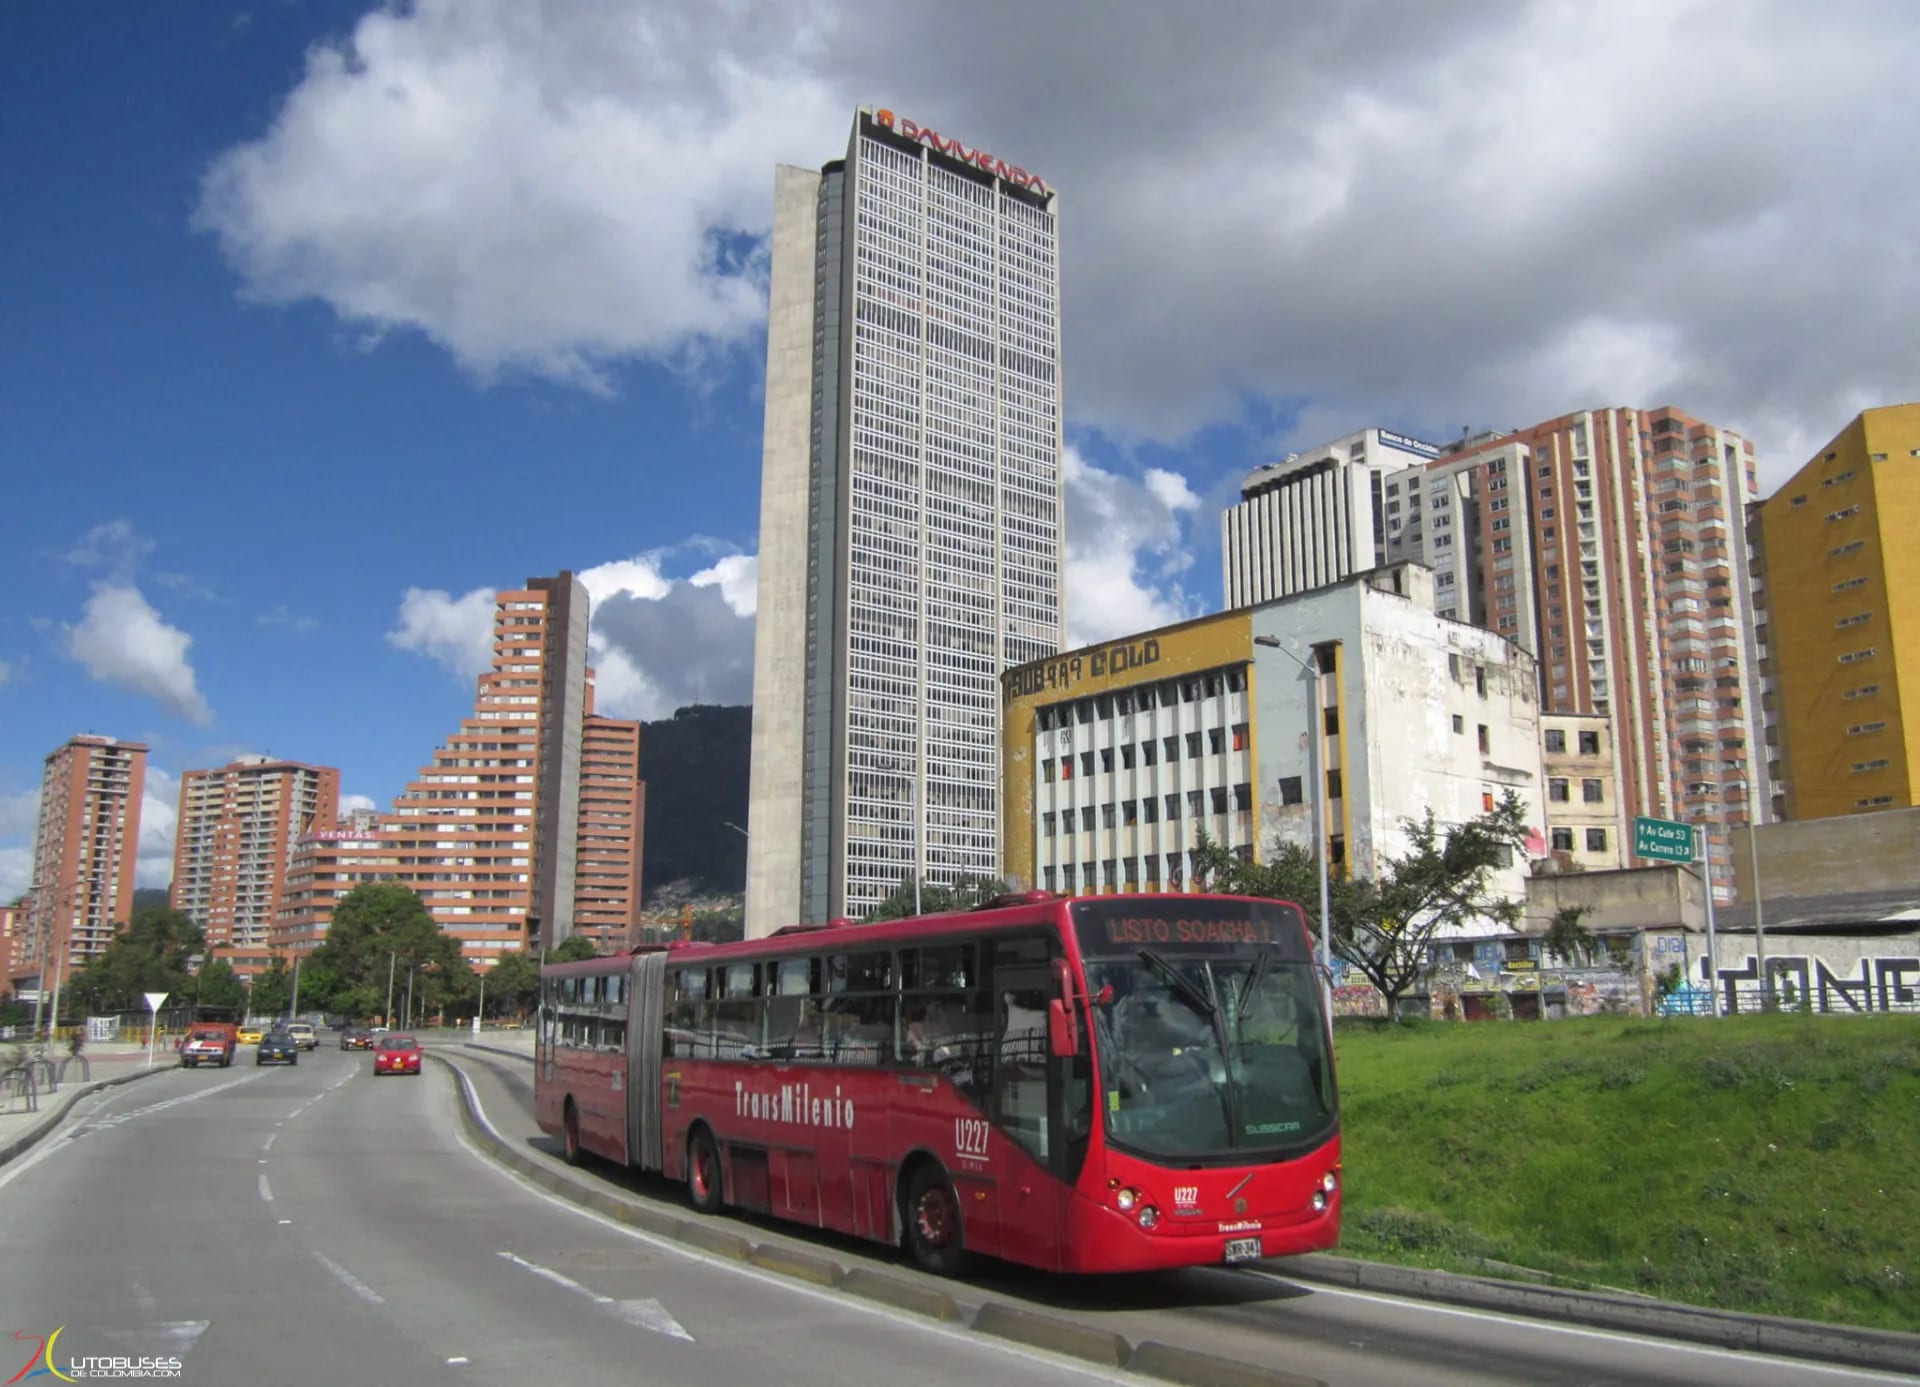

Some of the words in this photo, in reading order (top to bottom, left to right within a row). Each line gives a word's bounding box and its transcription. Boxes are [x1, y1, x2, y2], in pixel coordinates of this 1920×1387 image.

[901, 118, 1046, 194] DAVIVIENDA
[319, 831, 372, 839] VENTAS
[1646, 825, 1656, 836] Av
[1639, 840, 1648, 851] Av
[735, 1081, 854, 1129] TransMilenio
[955, 1117, 990, 1154] U227
[1174, 1187, 1198, 1202] U227
[1218, 1220, 1262, 1233] TransMilenio
